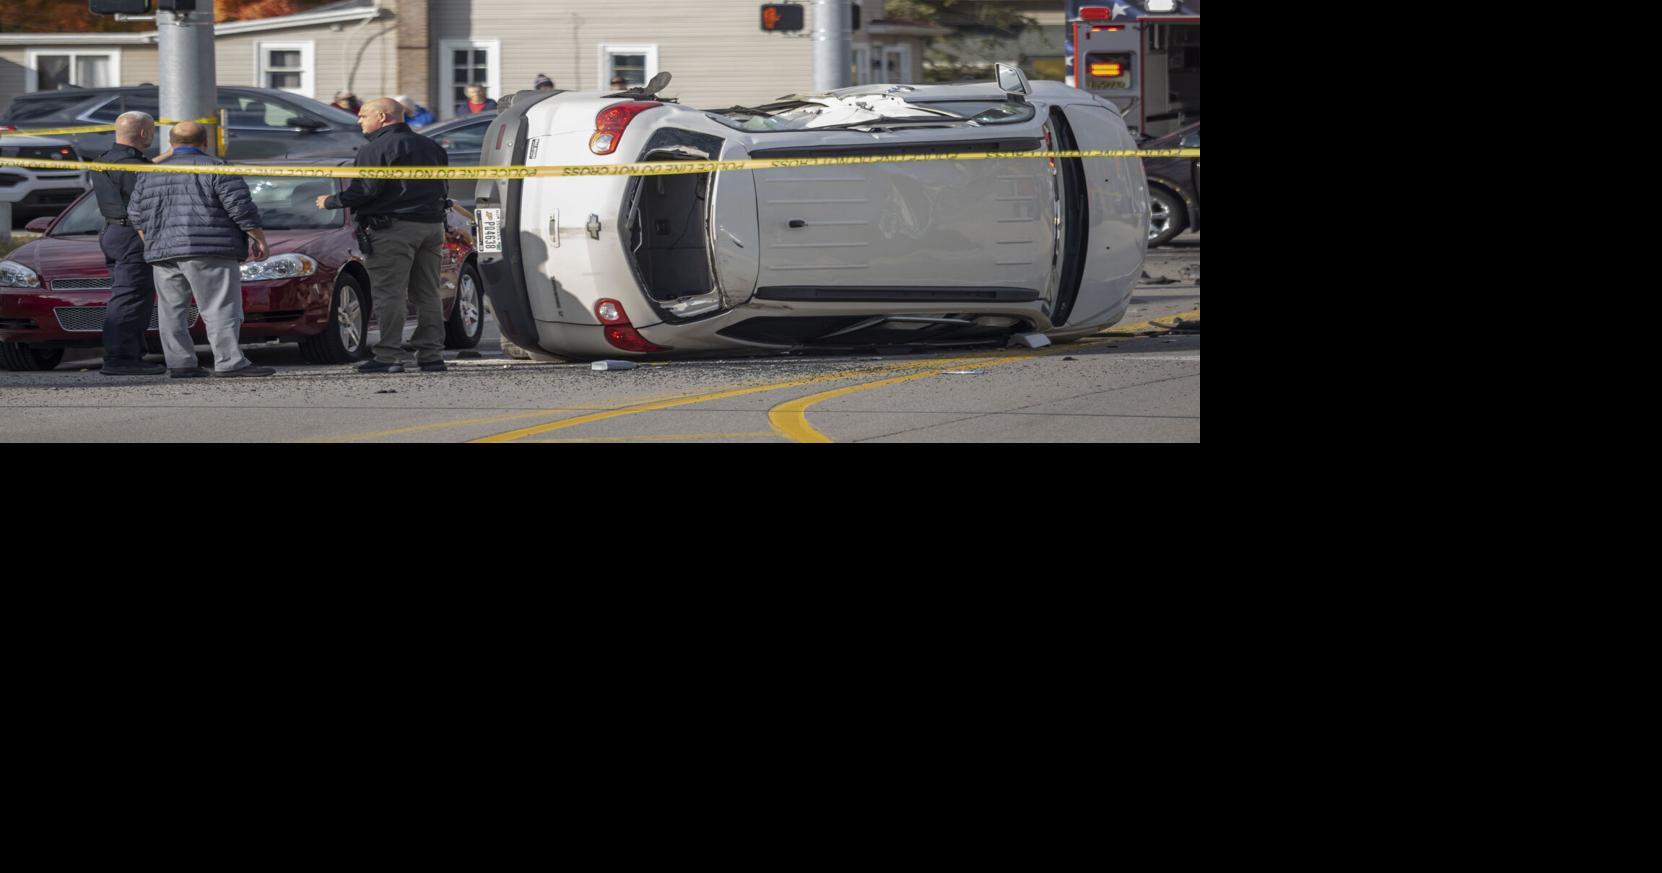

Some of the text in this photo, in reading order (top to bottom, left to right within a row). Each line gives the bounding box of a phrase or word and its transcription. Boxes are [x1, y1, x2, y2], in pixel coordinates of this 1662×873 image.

[359, 169, 537, 178] POLICE LINE DO NOT CROSS
[563, 162, 744, 176] POLICE LINE DO NOT CROSS
